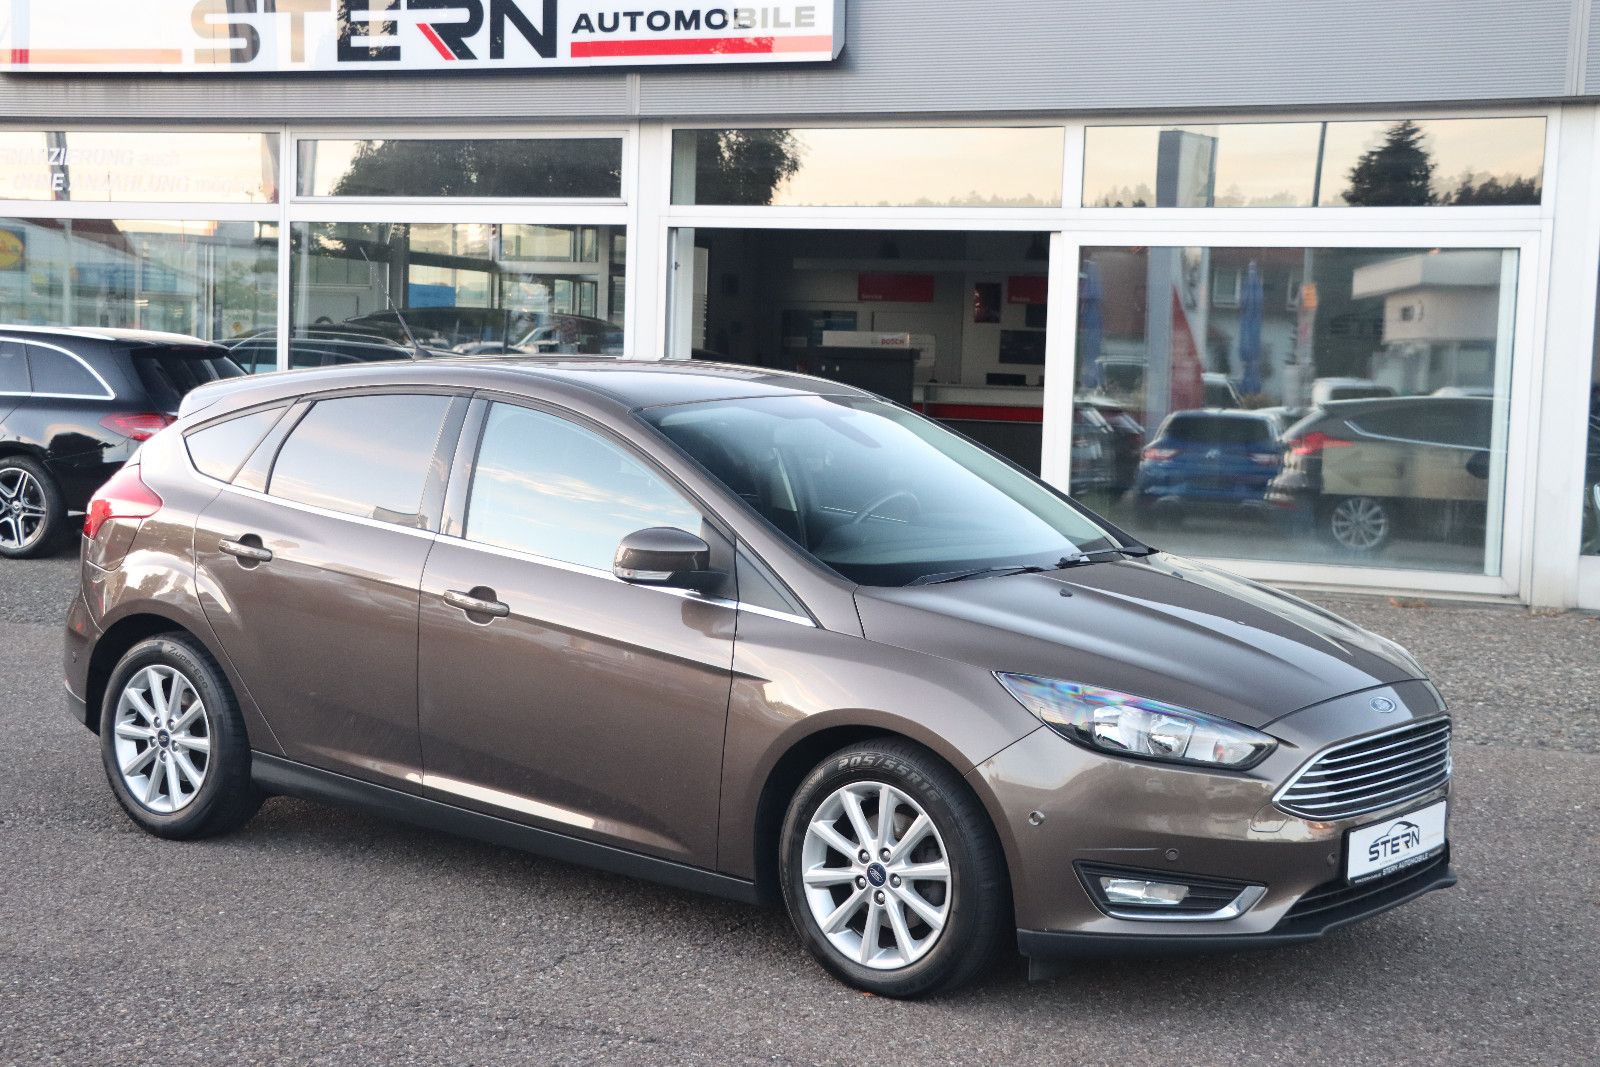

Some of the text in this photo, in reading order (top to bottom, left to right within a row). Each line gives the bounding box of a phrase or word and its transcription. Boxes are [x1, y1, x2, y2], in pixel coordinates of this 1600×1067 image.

[190, 0, 558, 64] STERN
[571, 5, 816, 34] AUTOMOBILE
[1368, 828, 1420, 863] STERN
